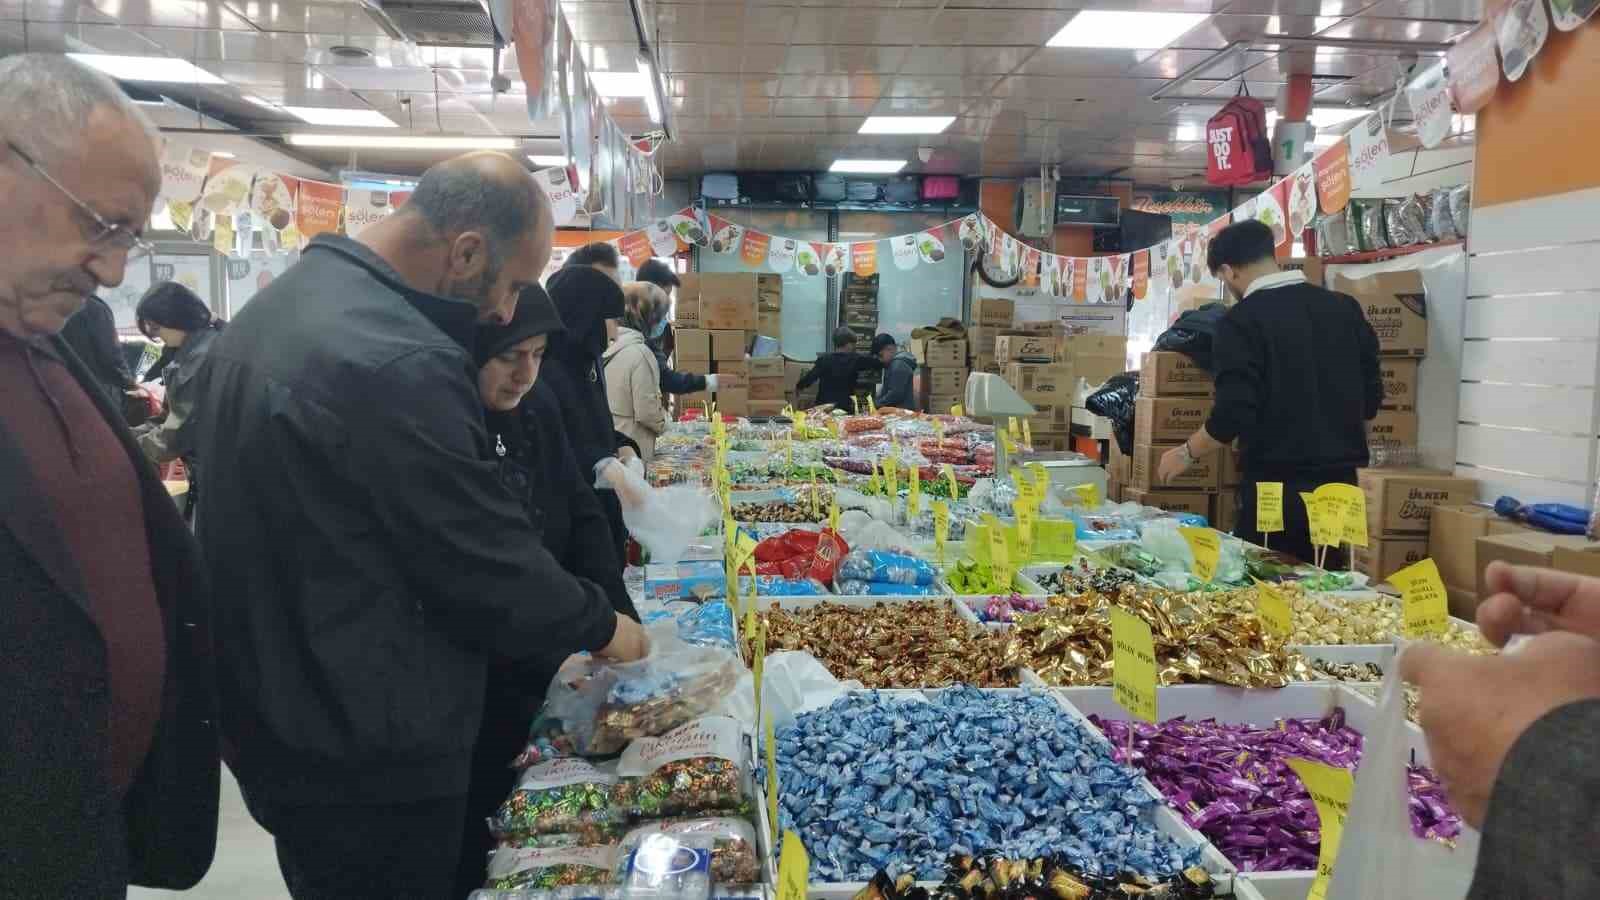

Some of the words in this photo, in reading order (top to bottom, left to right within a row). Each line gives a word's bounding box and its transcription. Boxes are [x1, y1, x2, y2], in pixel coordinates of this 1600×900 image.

[1209, 127, 1232, 143] JUST
[1213, 142, 1231, 157] DO
[1281, 139, 1295, 160] 1
[1408, 487, 1449, 500] ÜLKER
